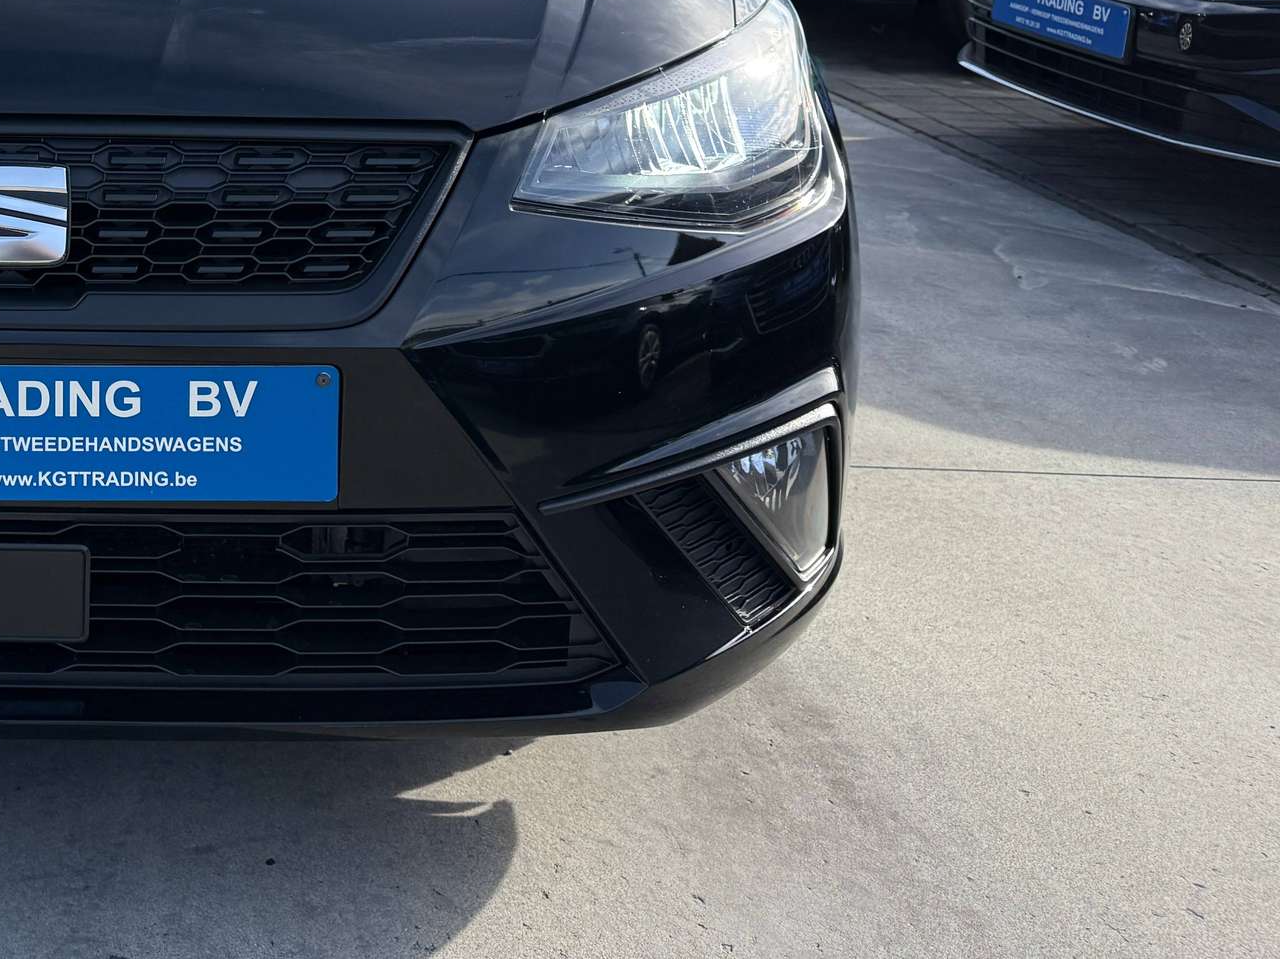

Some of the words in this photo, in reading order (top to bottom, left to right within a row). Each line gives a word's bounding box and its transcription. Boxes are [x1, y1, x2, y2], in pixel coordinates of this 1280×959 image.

[1092, 5, 1112, 23] BV
[189, 380, 258, 417] BV
[0, 436, 243, 452] TWEEDEHANDSWAGENS
